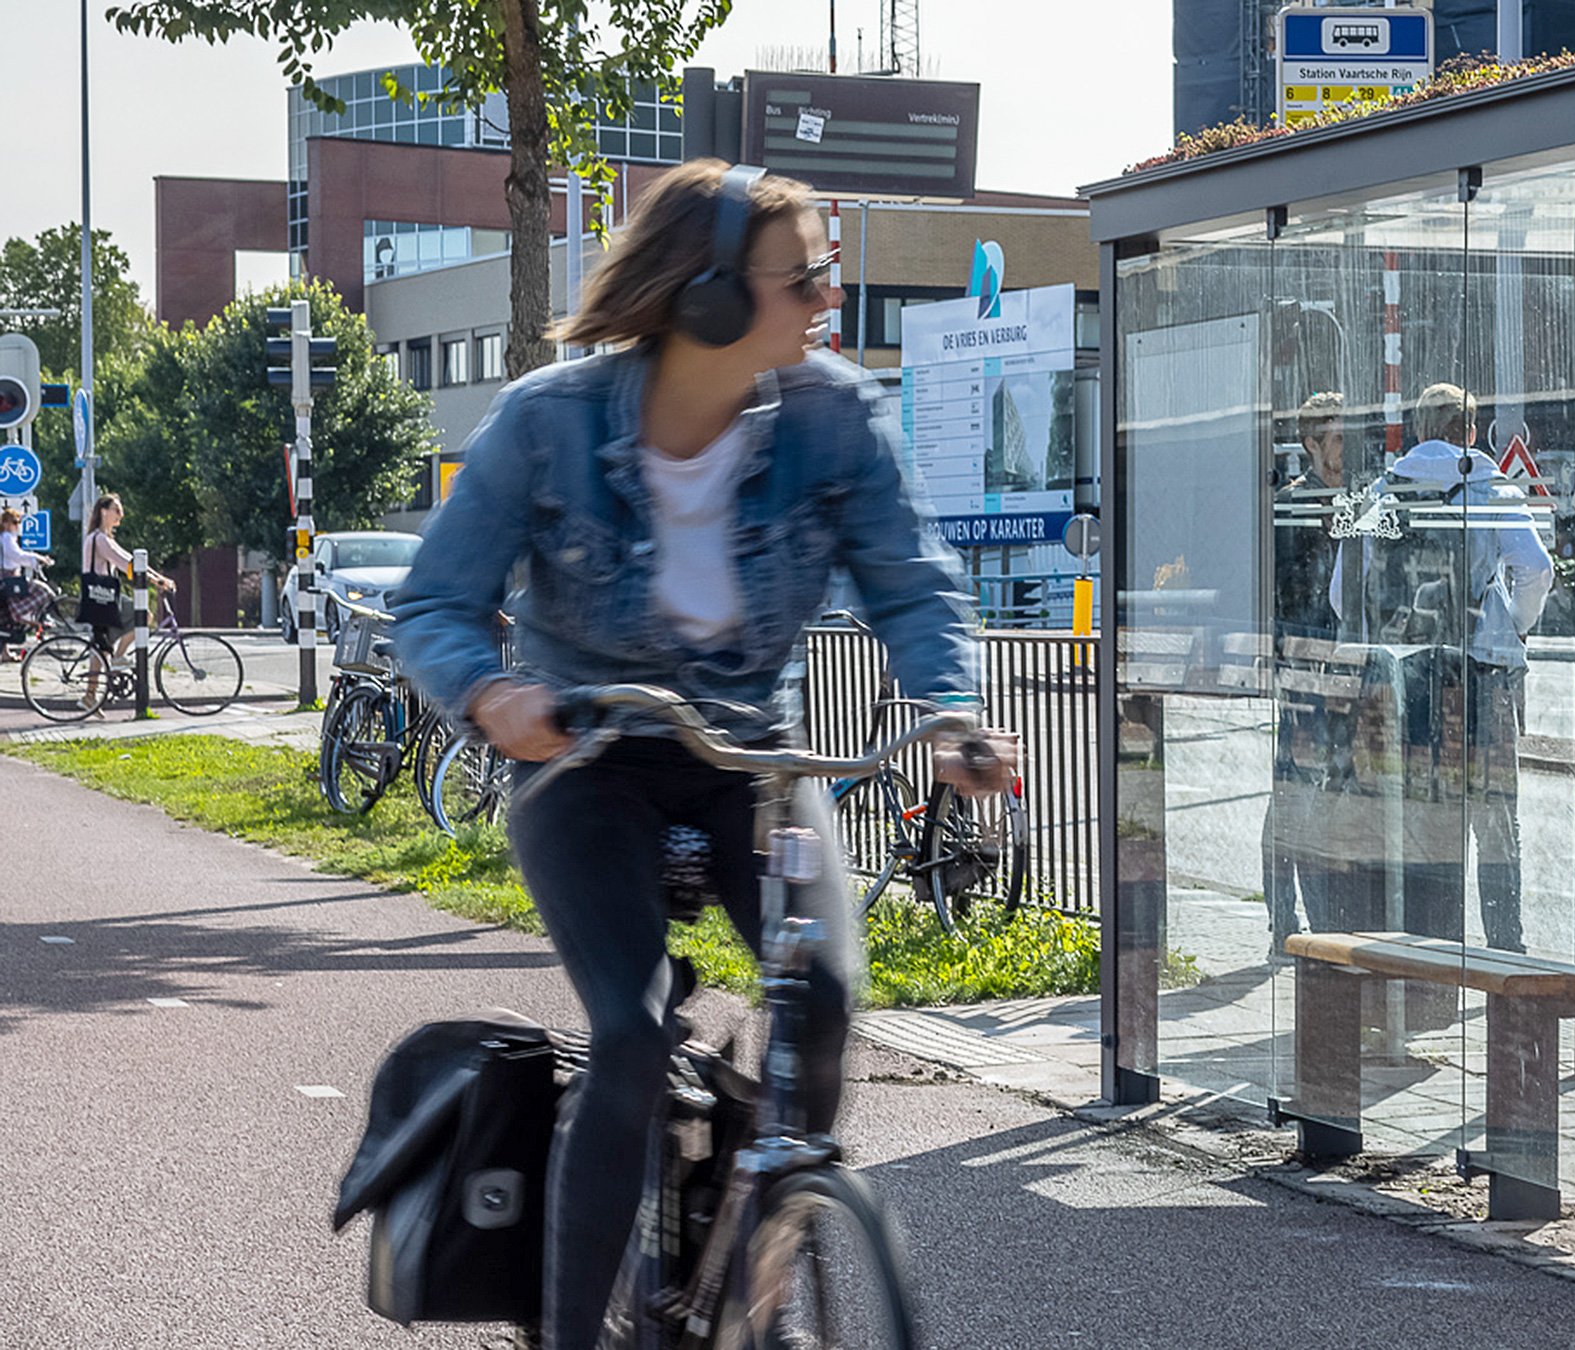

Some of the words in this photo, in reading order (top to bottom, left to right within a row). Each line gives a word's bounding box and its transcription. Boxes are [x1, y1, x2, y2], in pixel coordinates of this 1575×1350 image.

[1299, 68, 1336, 79] Station
[1338, 68, 1388, 79] Vaartsche
[1391, 68, 1412, 82] Rijn
[1286, 87, 1294, 100] 6
[1322, 87, 1331, 100] 8
[765, 105, 781, 115] Bus
[908, 112, 960, 125] Vertrek(min)
[942, 333, 954, 350] DE
[955, 330, 977, 349] VRIES
[978, 330, 989, 346] EN
[990, 324, 1027, 344] VERBURG
[972, 519, 988, 540] OP
[990, 517, 1046, 540] KARAKTER
